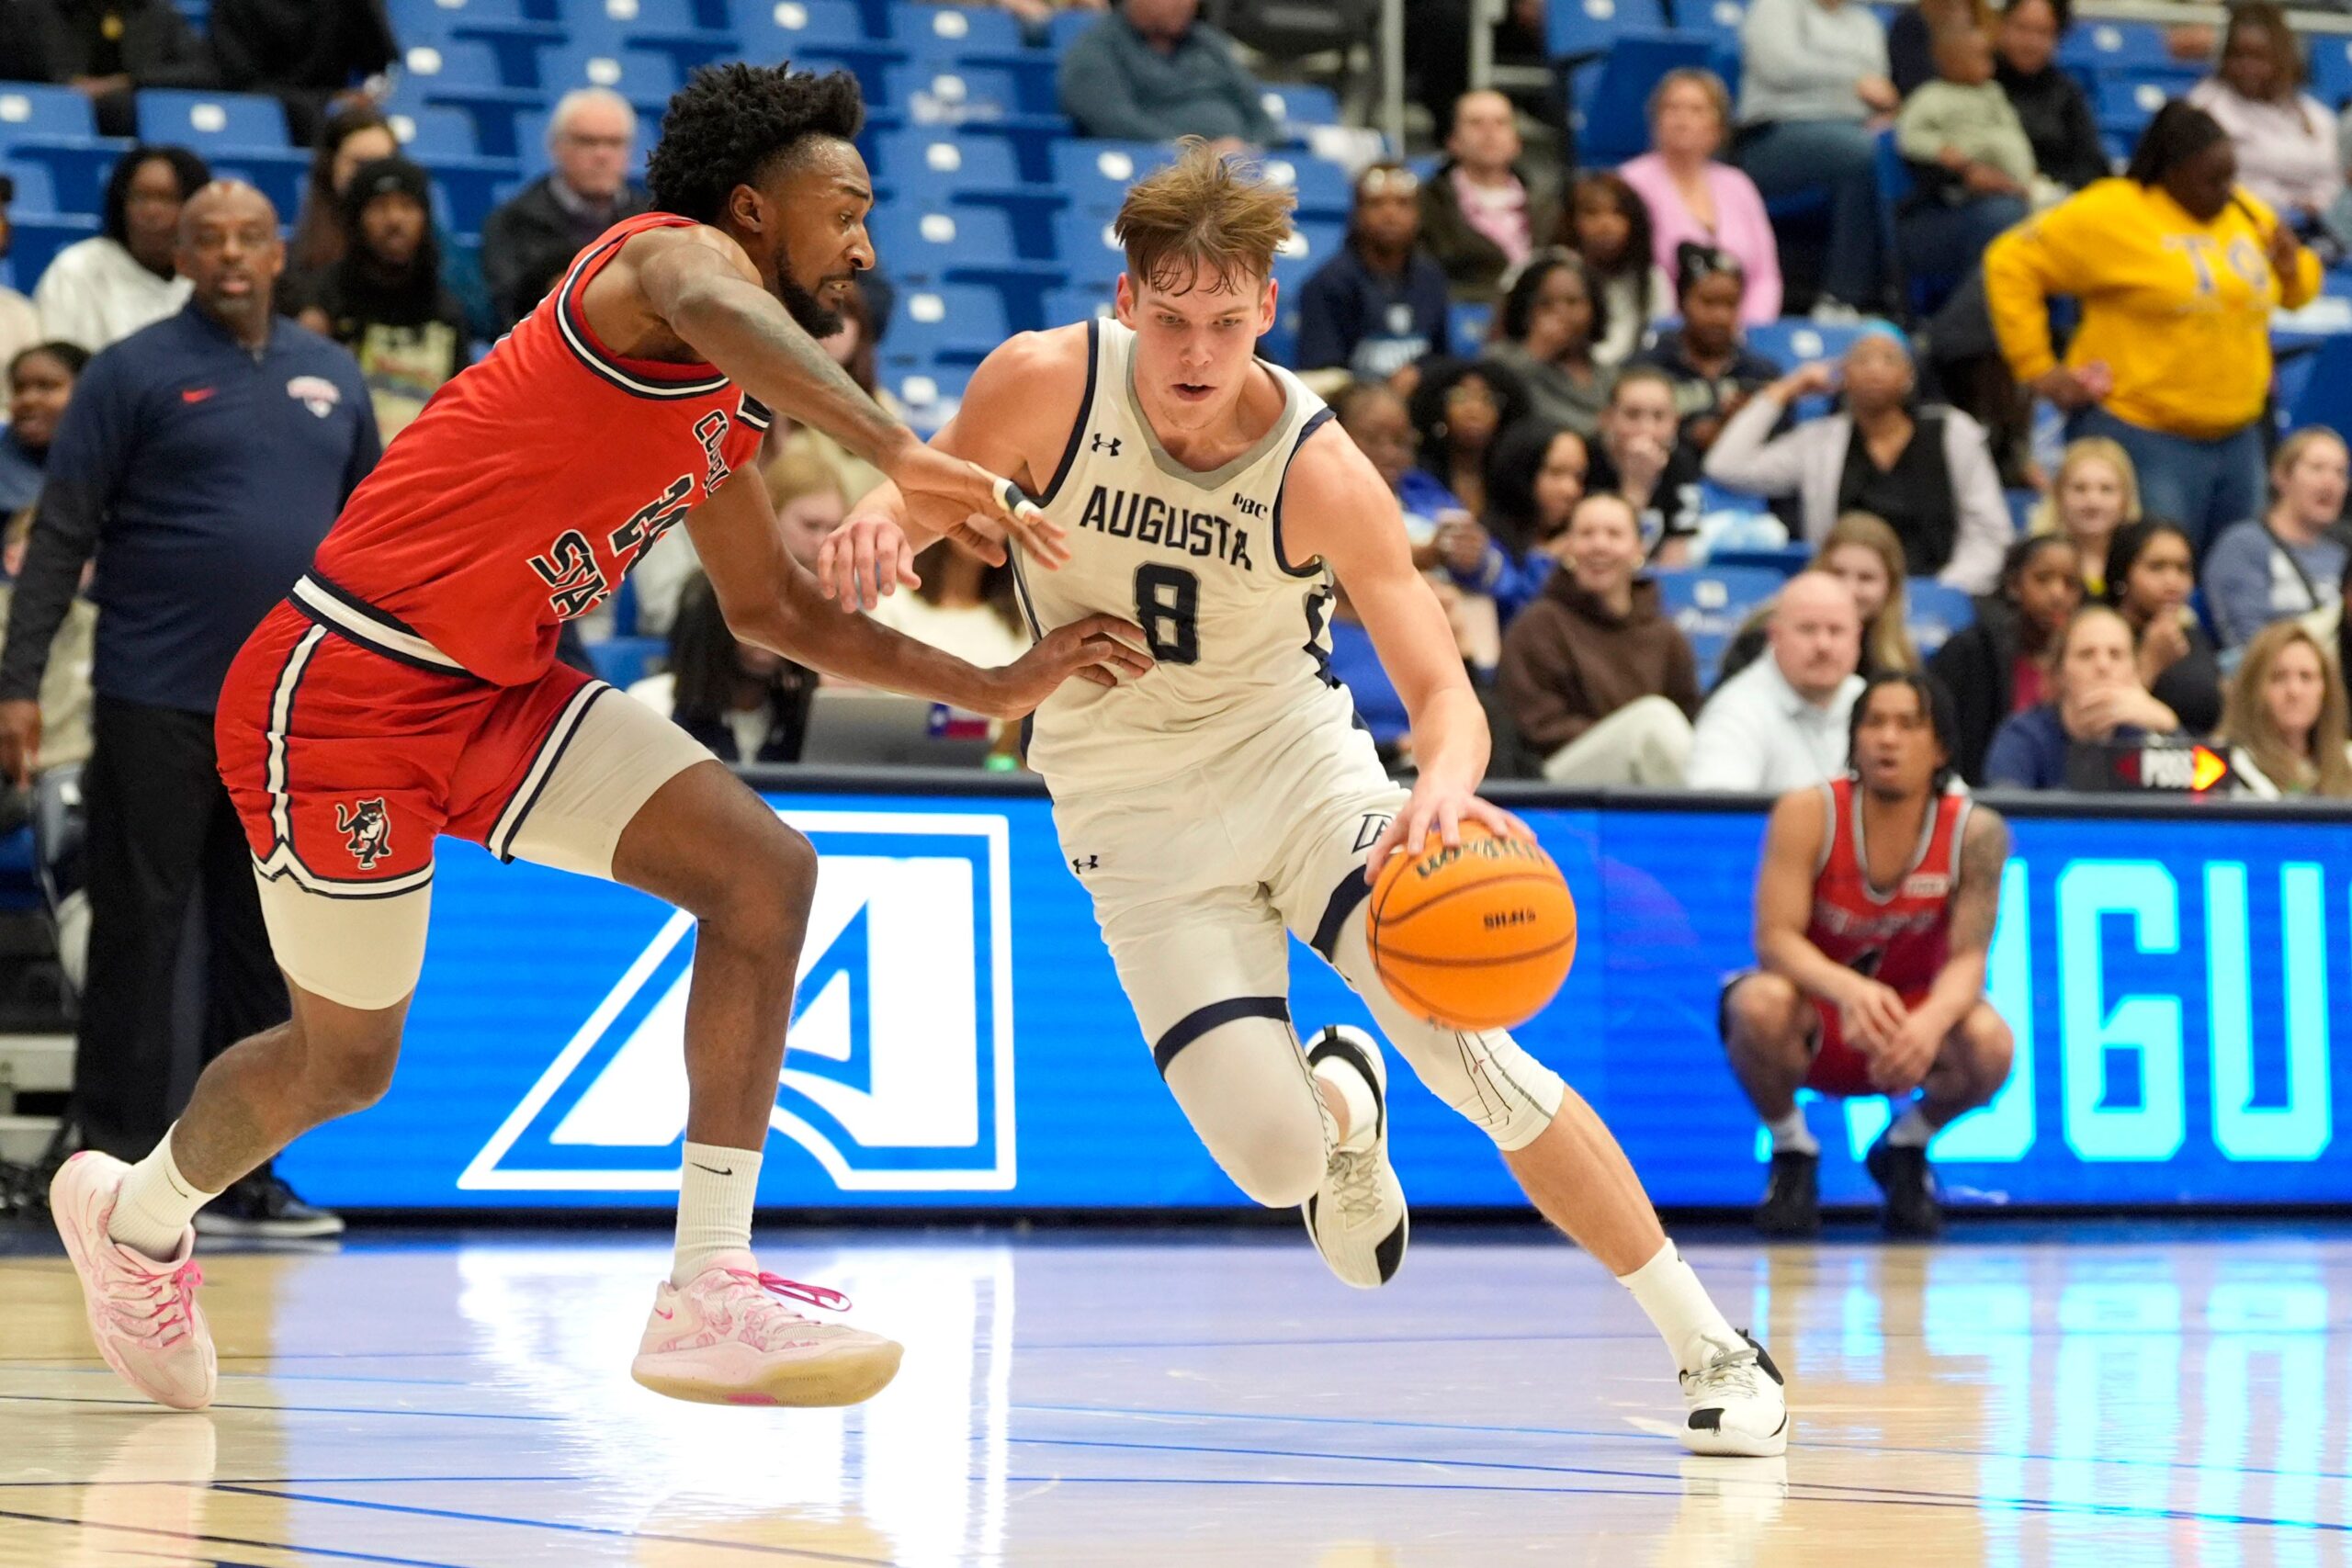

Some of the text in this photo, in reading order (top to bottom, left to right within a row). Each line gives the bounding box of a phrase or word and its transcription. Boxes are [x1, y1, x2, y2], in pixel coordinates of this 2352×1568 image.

[607, 472, 695, 582] 24
[1079, 484, 1253, 572] AUGUSTA
[1232, 492, 1268, 521] PBC
[526, 529, 611, 623] STA
[1133, 560, 1202, 666] 8
